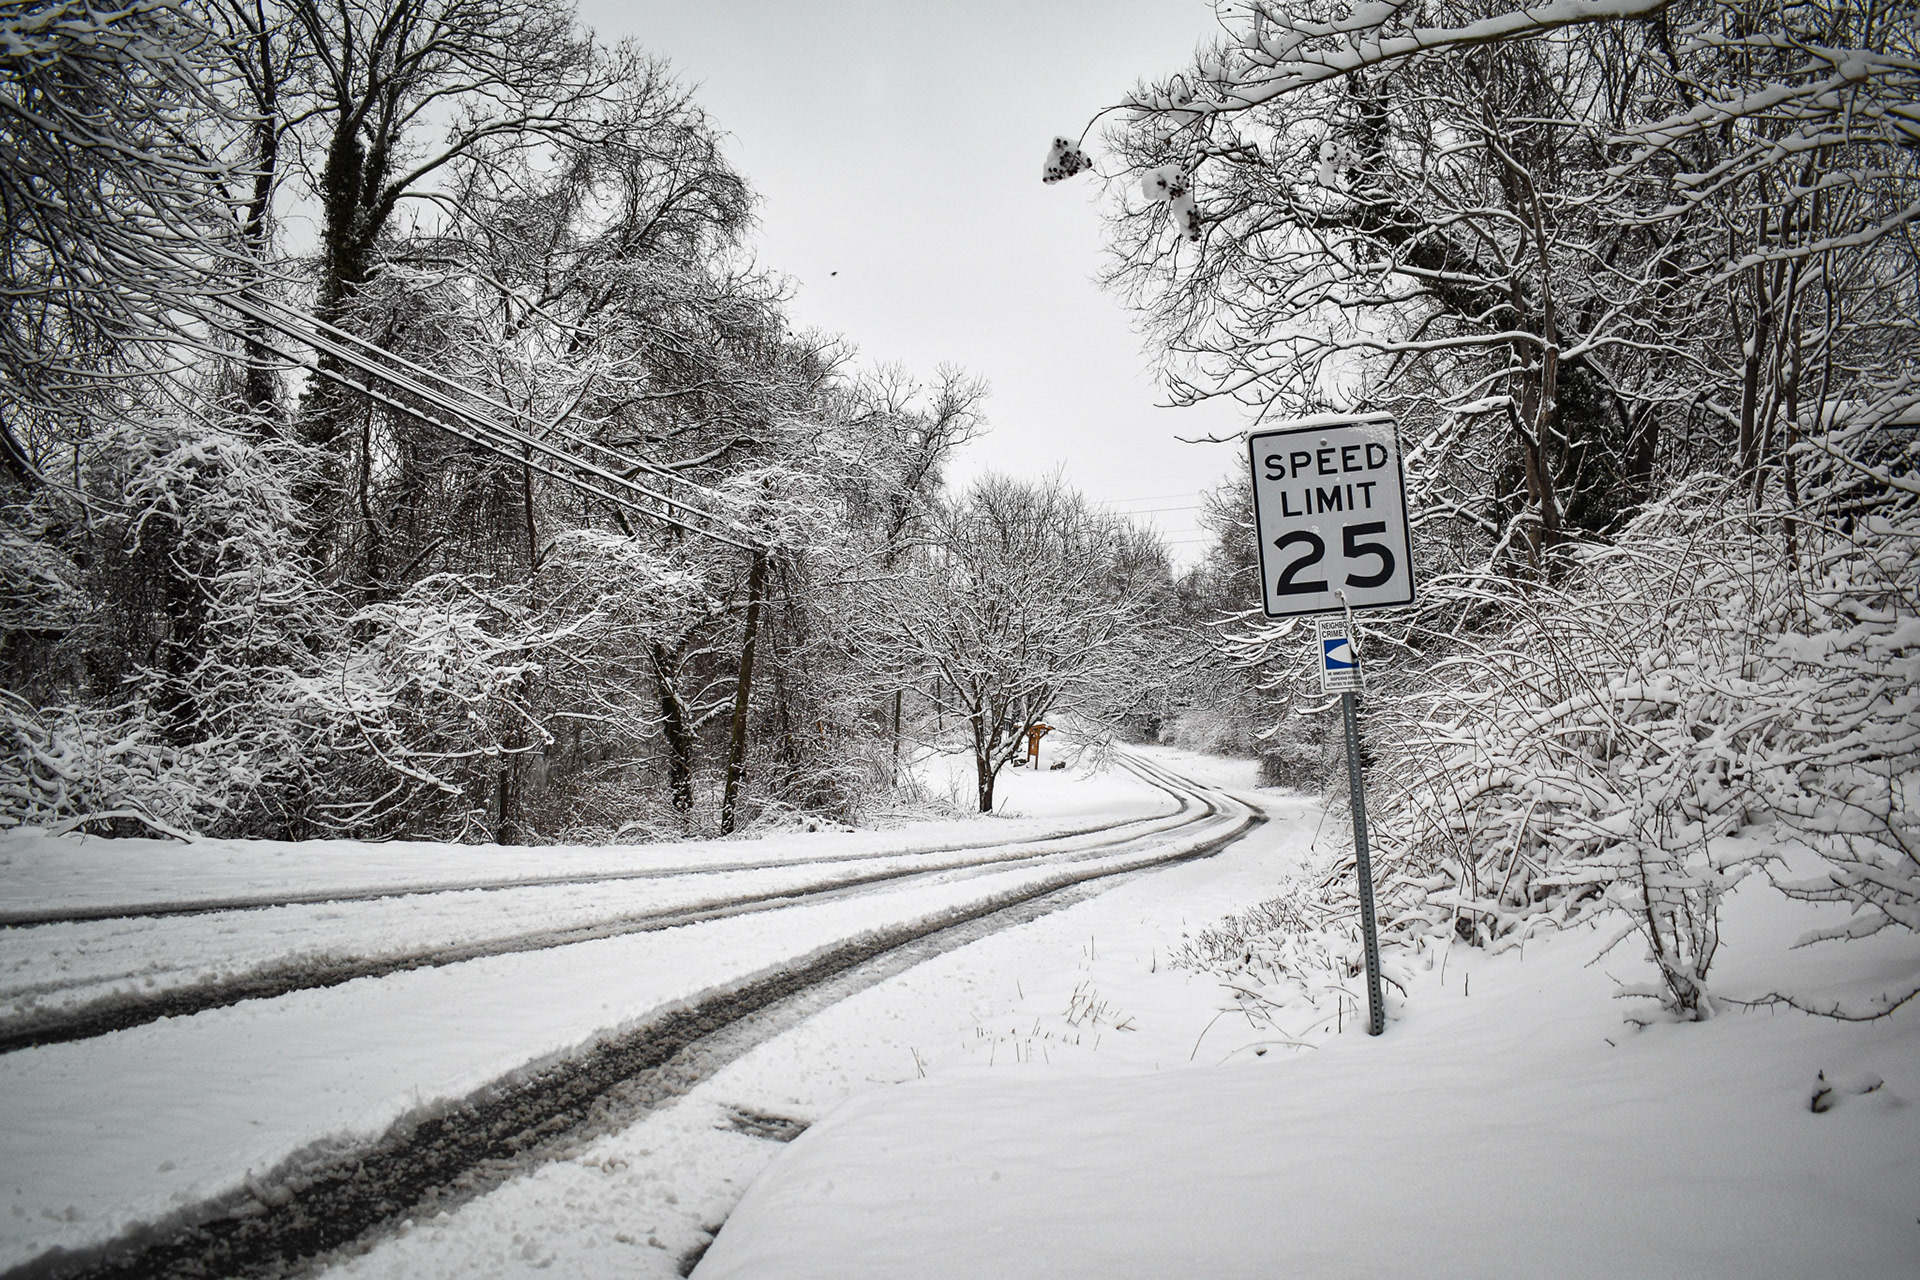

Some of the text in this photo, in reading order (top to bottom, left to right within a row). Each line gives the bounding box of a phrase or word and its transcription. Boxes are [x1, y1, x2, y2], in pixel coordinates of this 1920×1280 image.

[1264, 442, 1389, 482] SPEED
[1280, 480, 1377, 518] LIMIT
[1273, 520, 1396, 597] 25
[1321, 621, 1349, 630] NEIGHBO
[1321, 629, 1343, 638] CRIME
